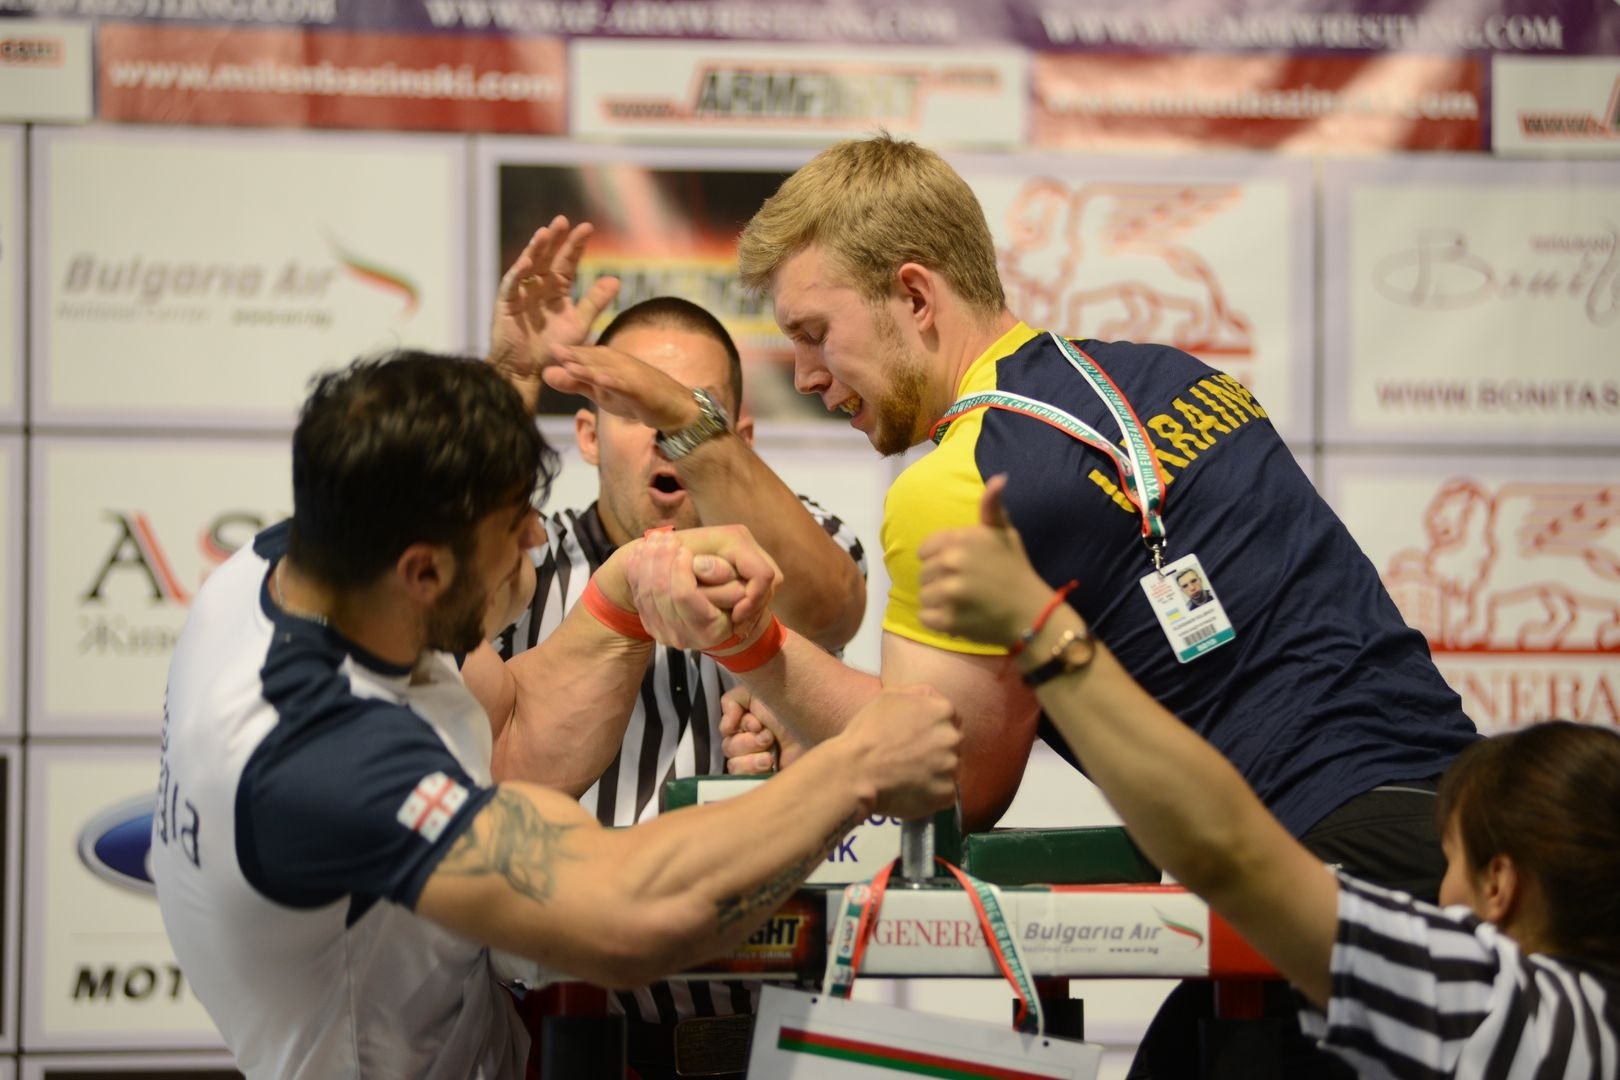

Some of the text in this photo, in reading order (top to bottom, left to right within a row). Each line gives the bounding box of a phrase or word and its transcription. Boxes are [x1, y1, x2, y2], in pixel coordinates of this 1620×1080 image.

[64, 253, 335, 305] Bulgaria Air
[1010, 399, 1090, 438] CHAMPIONSHIP
[1125, 419, 1153, 466] EUROPEAN
[1024, 922, 1163, 944] Bulgaria Air
